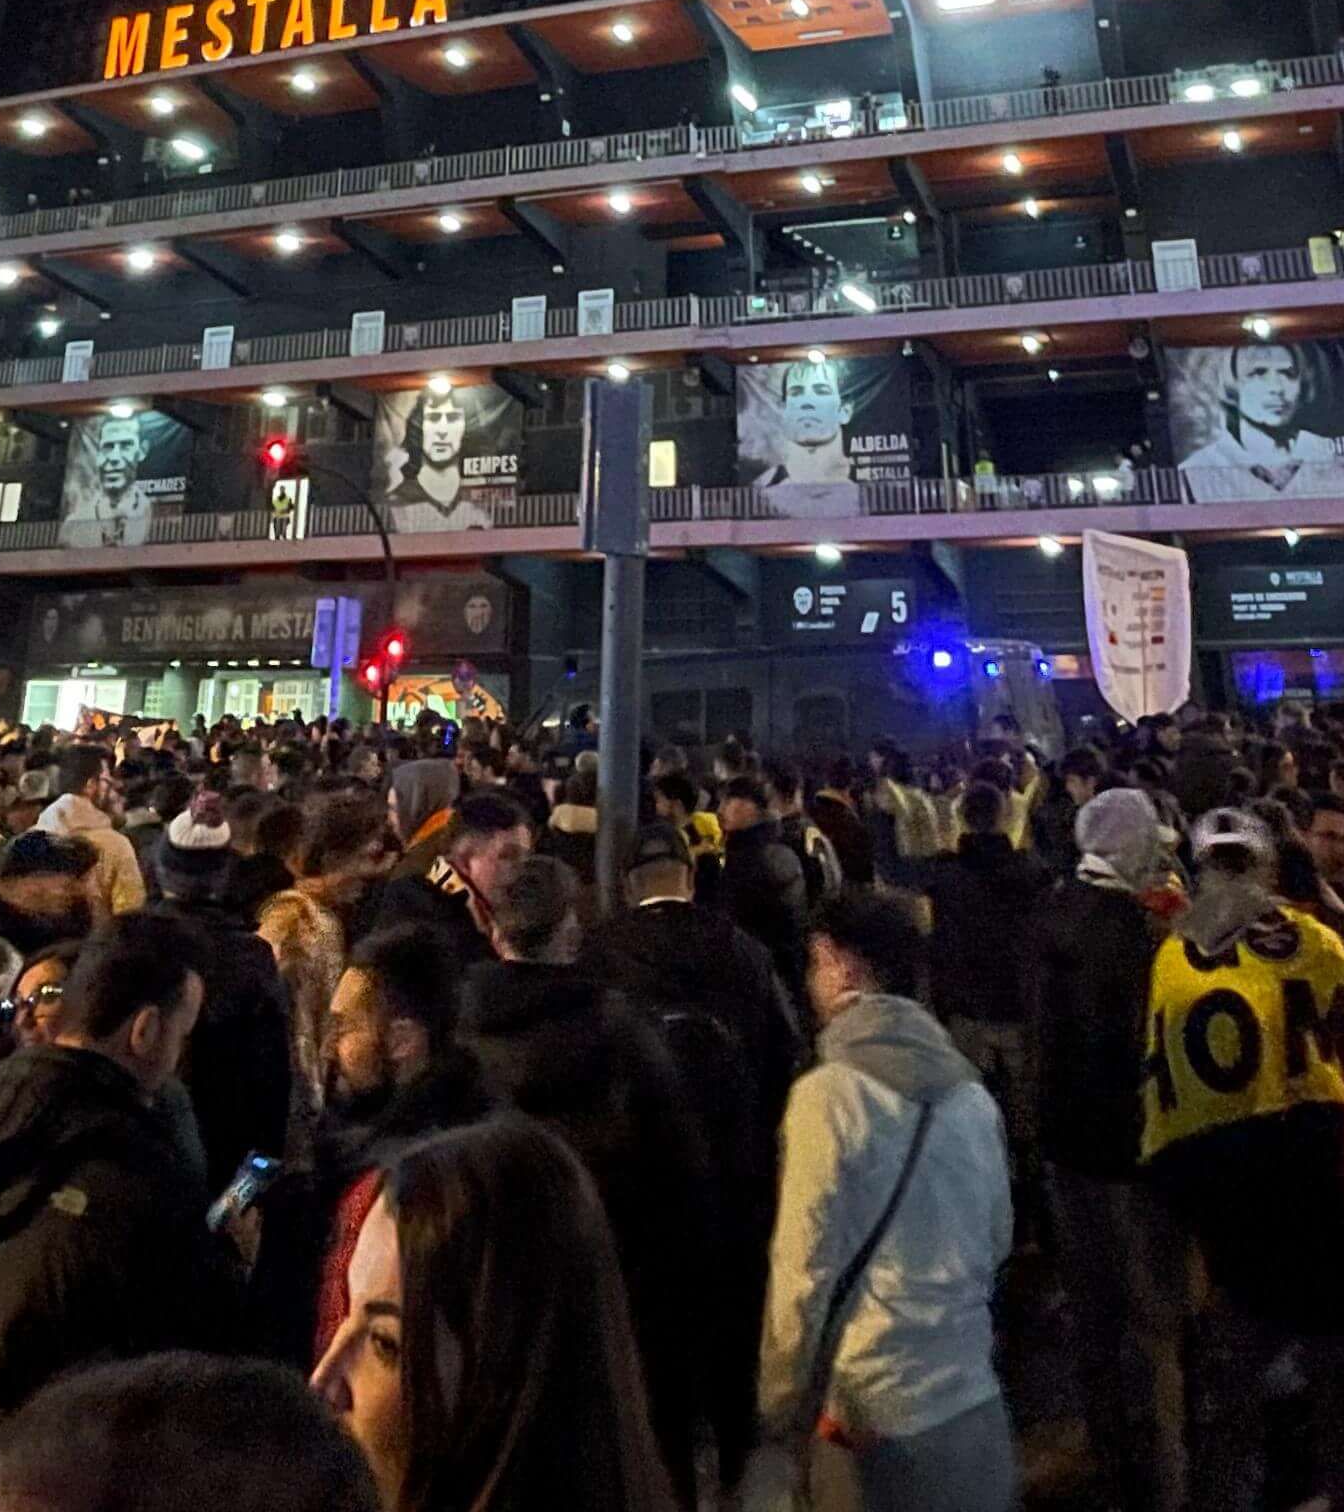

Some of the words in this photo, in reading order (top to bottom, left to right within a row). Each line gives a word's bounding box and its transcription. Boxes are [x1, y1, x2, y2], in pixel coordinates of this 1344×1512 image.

[849, 433, 909, 453] ALBELDA
[463, 454, 518, 475] KEMPES
[891, 590, 907, 623] 5
[231, 614, 245, 641] A
